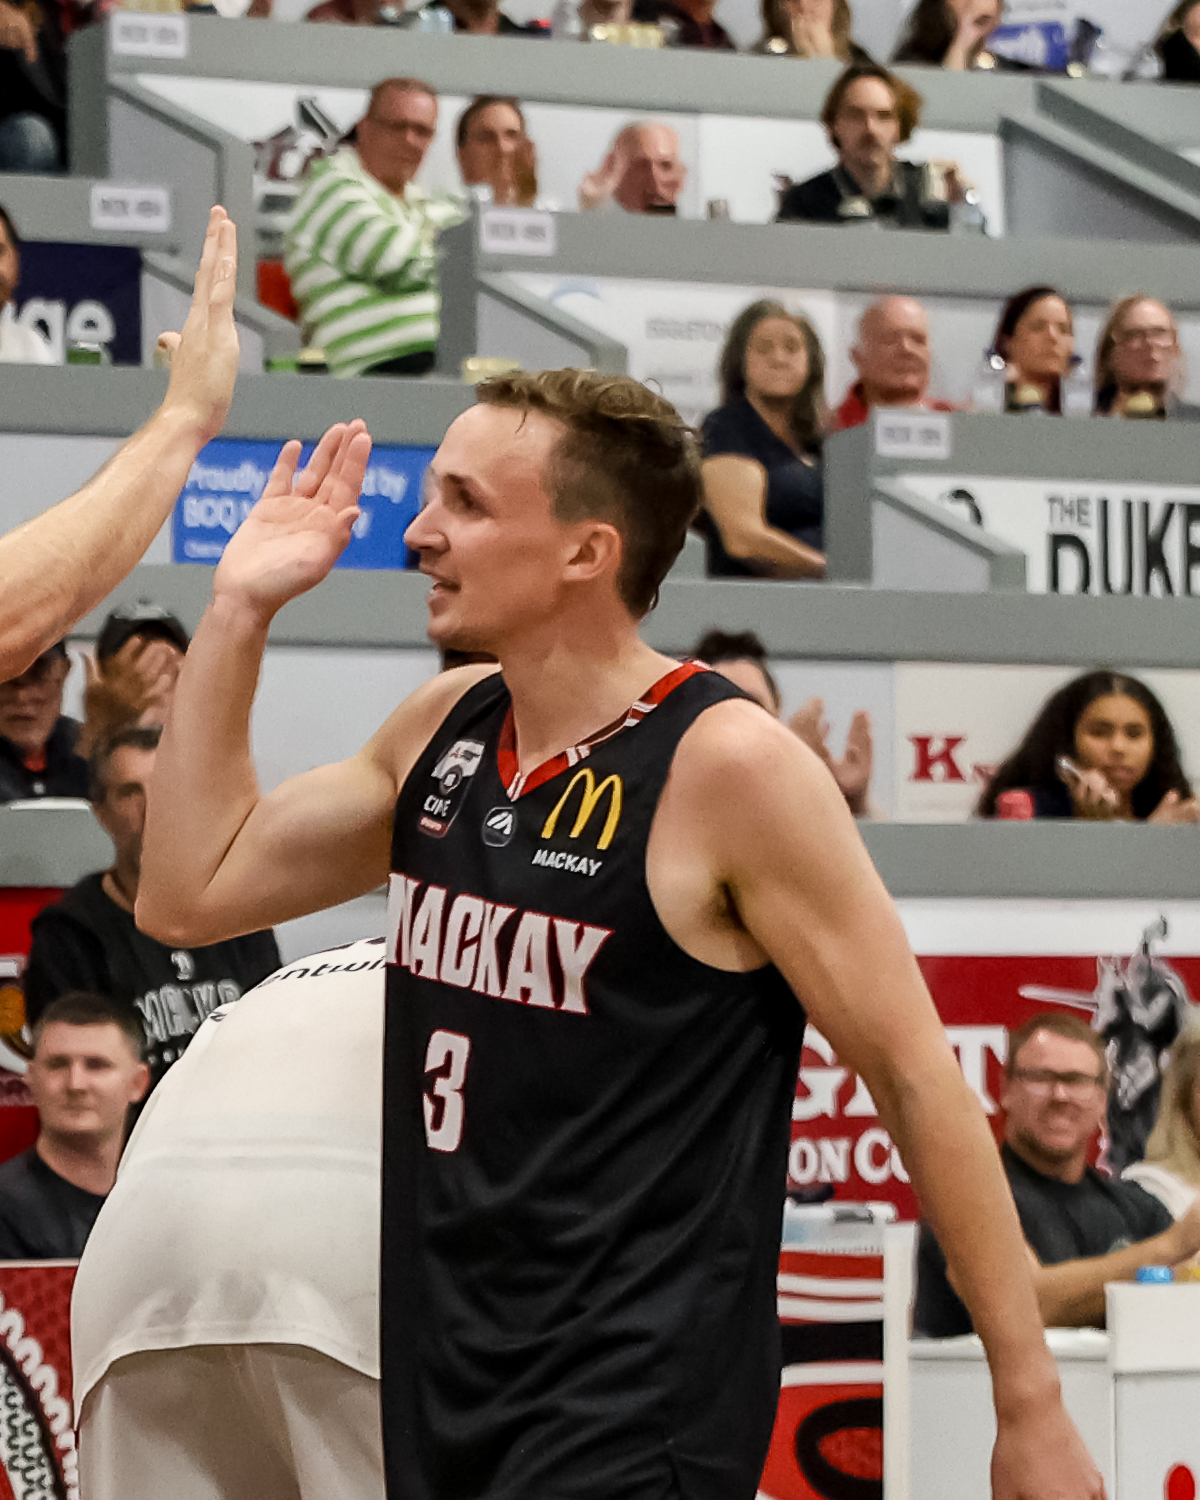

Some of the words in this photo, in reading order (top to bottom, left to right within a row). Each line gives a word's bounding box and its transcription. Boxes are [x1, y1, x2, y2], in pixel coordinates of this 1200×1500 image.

[1047, 498, 1091, 527] THE
[531, 848, 603, 877] MACKAY
[422, 1028, 472, 1153] 3
